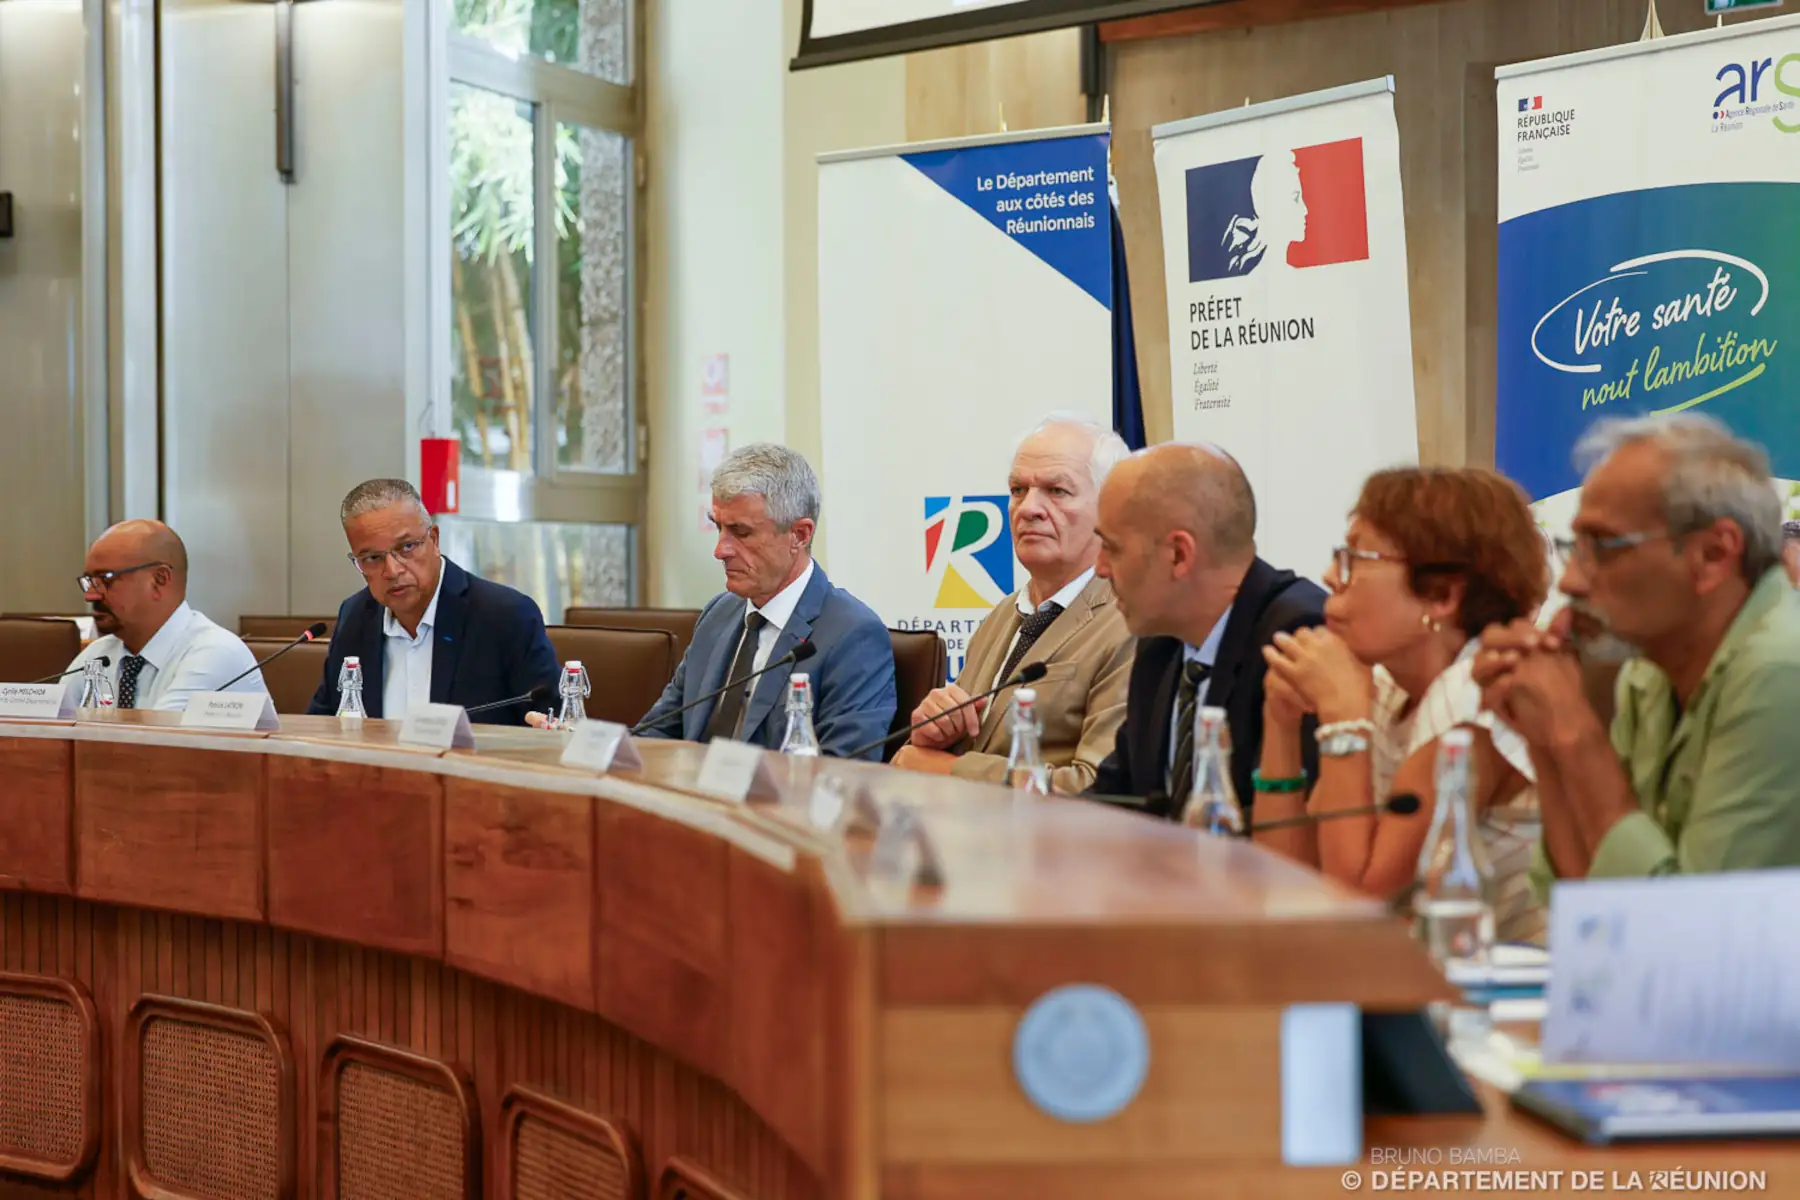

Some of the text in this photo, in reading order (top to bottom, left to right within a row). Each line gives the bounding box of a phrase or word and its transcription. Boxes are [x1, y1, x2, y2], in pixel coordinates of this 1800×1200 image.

[1517, 109, 1575, 128] RÉPUBLIQUE
[1517, 124, 1571, 142] FRANÇAISE
[977, 166, 1094, 191] Le Département
[996, 190, 1095, 213] aux côtés des
[1006, 212, 1095, 234] Réunionnais
[1190, 295, 1242, 322] PRÉFET
[1575, 266, 1737, 355] Votre santé
[1191, 317, 1315, 350] DE LA RÉUNION
[1193, 361, 1219, 375] Liberté
[1582, 331, 1777, 410] nout lambition
